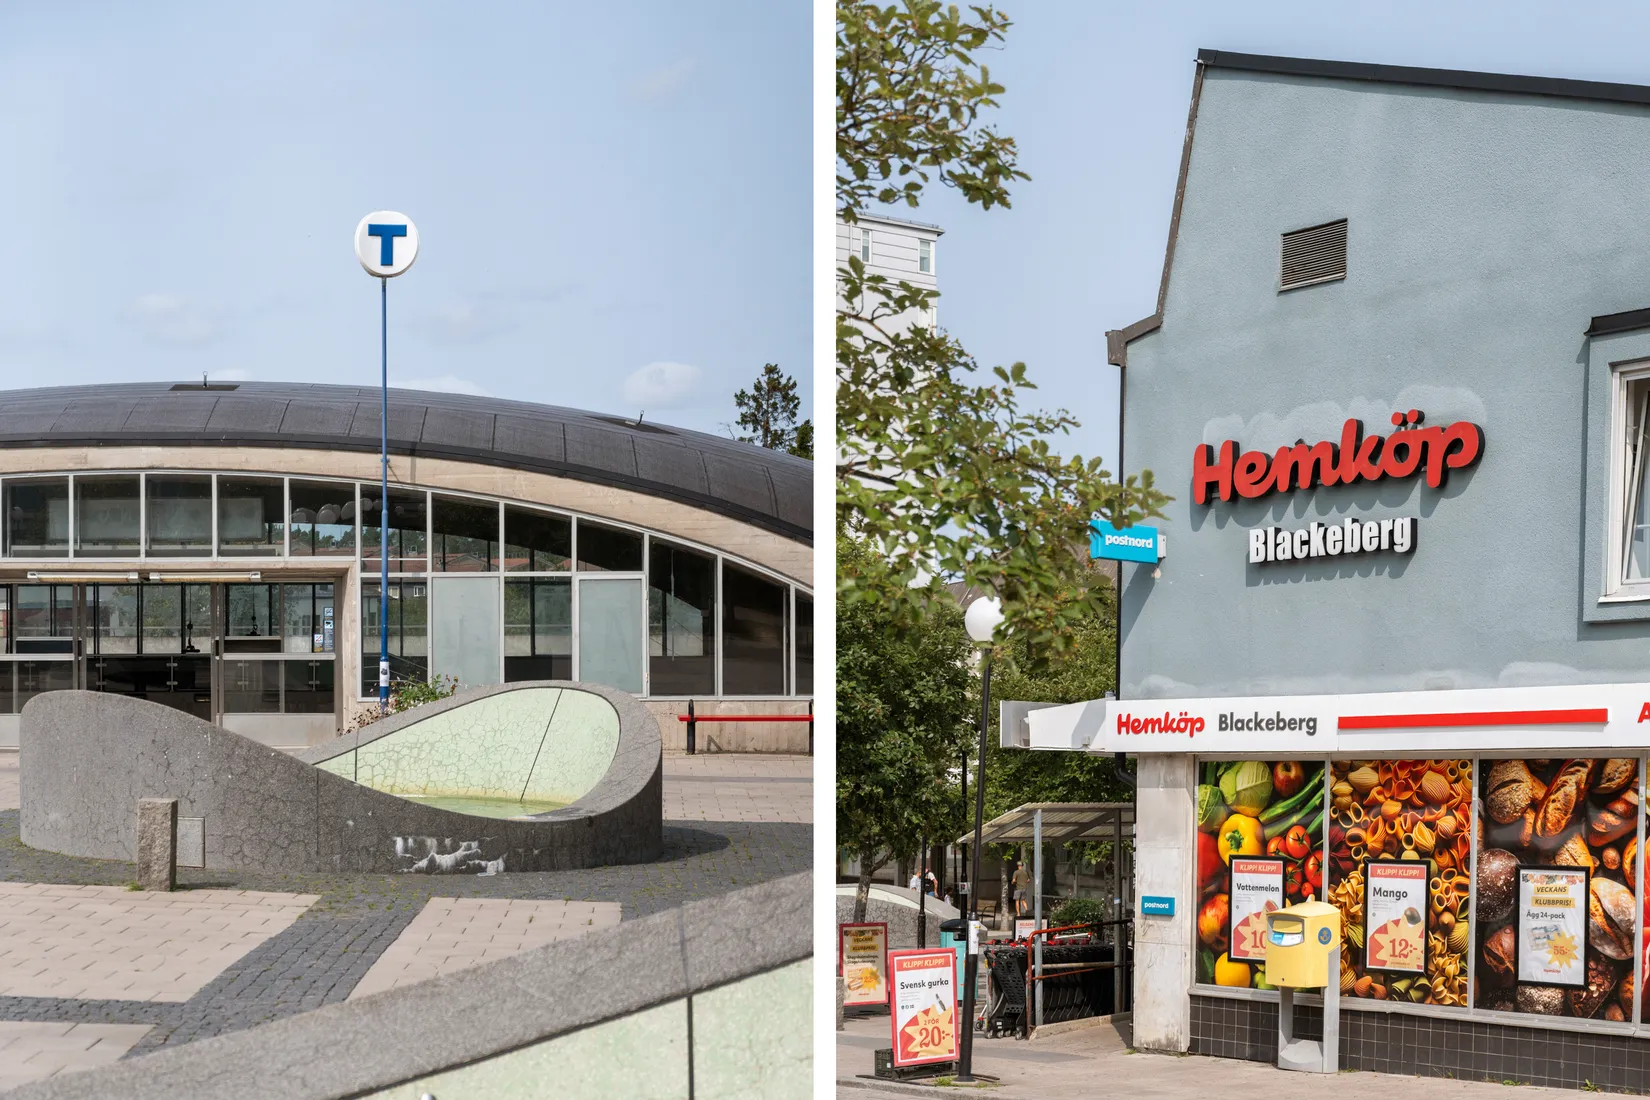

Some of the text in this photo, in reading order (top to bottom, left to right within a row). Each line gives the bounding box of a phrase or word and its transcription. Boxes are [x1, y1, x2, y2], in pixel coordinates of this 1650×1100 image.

[367, 223, 407, 267] T
[1193, 409, 1486, 505] Hemköp
[1105, 534, 1153, 549] postnord
[1249, 516, 1418, 564] Blackeberg
[1116, 711, 1318, 738] Hemköp Blackeberg
[1239, 864, 1258, 872] KLIPP!
[1376, 867, 1420, 877] KLIPP! KLIPP!
[1236, 882, 1280, 893] Vattenmelon
[1372, 886, 1408, 901] Mango
[1534, 898, 1572, 907] KLUBBPRIS!
[1540, 911, 1565, 920] 24-pack
[1388, 937, 1418, 959] 12:-
[902, 958, 945, 969] KLIPP! KLIPP!
[900, 977, 949, 990] Svensk gurka
[919, 1026, 950, 1048] 20:-
